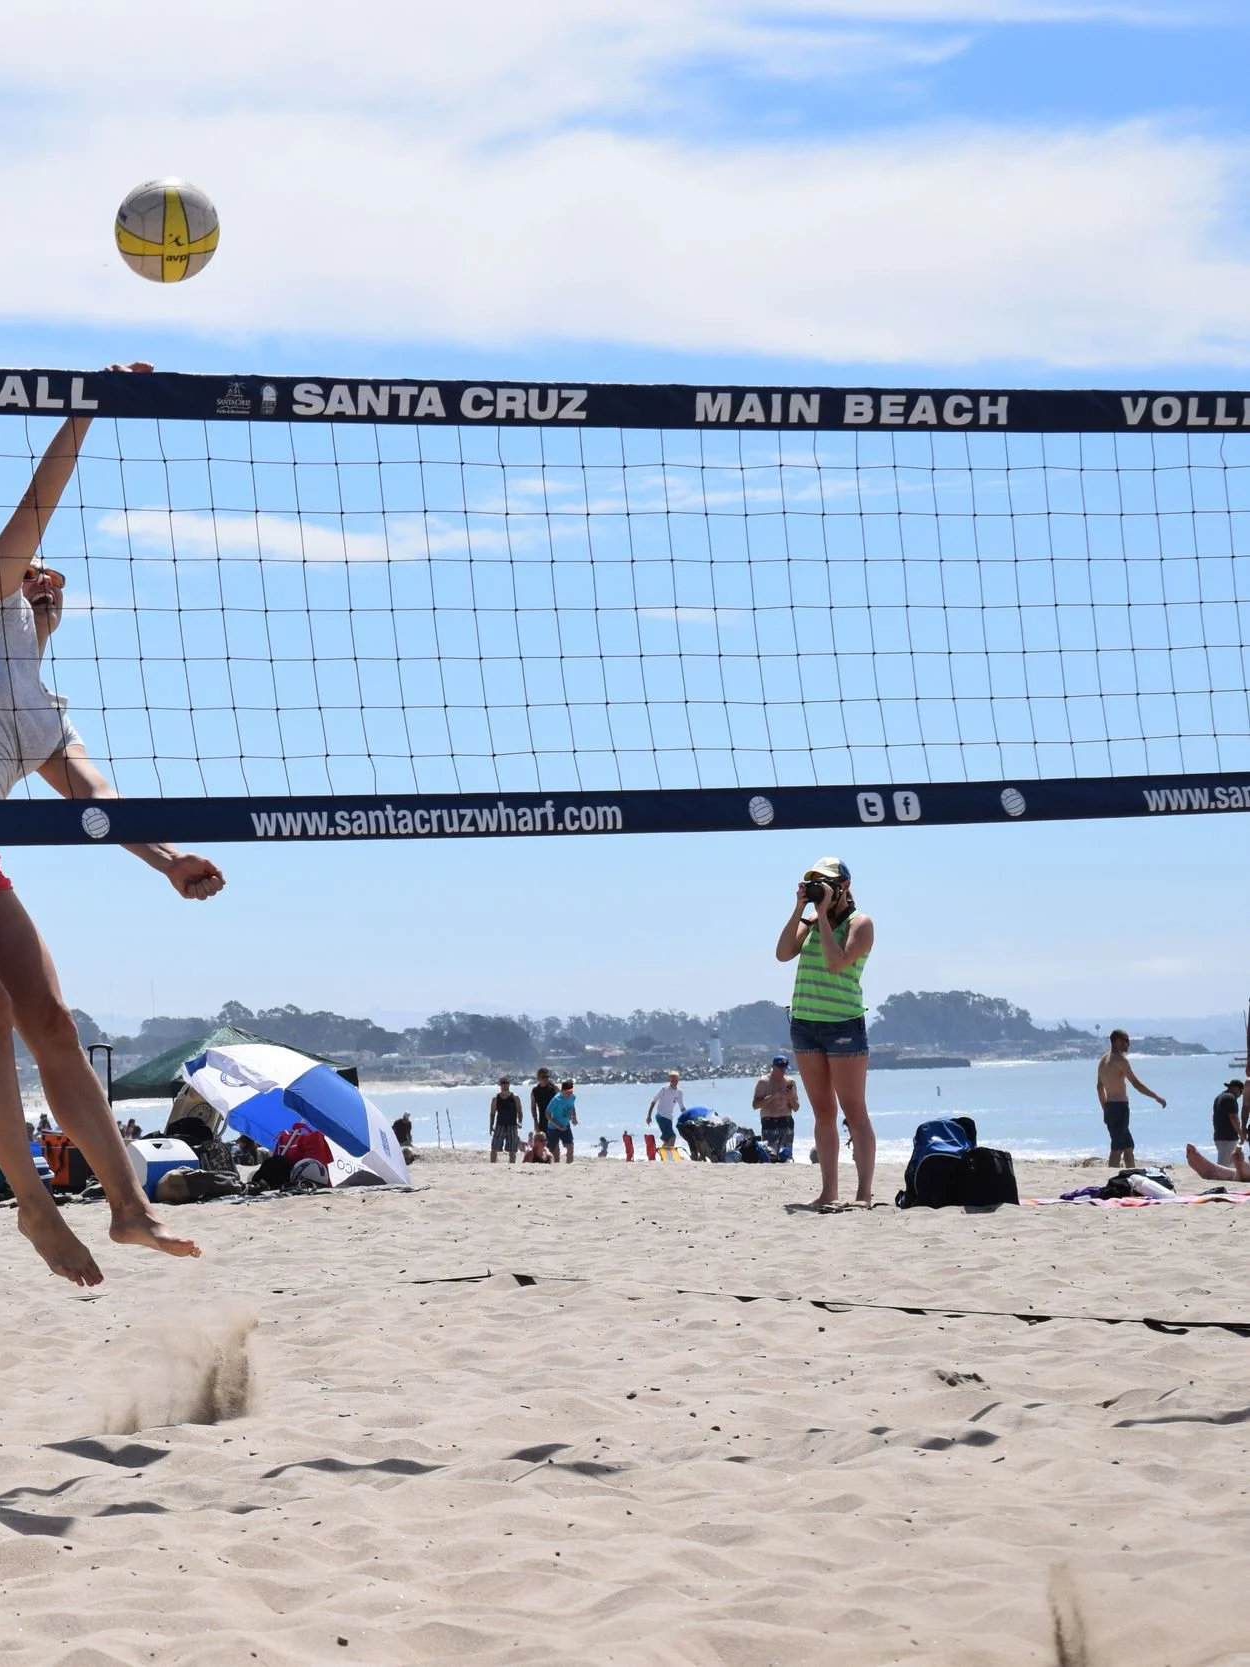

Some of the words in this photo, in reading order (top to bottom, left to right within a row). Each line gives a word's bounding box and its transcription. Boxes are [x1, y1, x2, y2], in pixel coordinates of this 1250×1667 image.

[166, 254, 187, 263] avp
[292, 383, 446, 418] SANTA
[460, 387, 587, 420] CRUZ
[695, 392, 820, 423] MAIN
[843, 395, 1009, 426] BEACH
[251, 800, 623, 837] www.santacruzwharf.com
